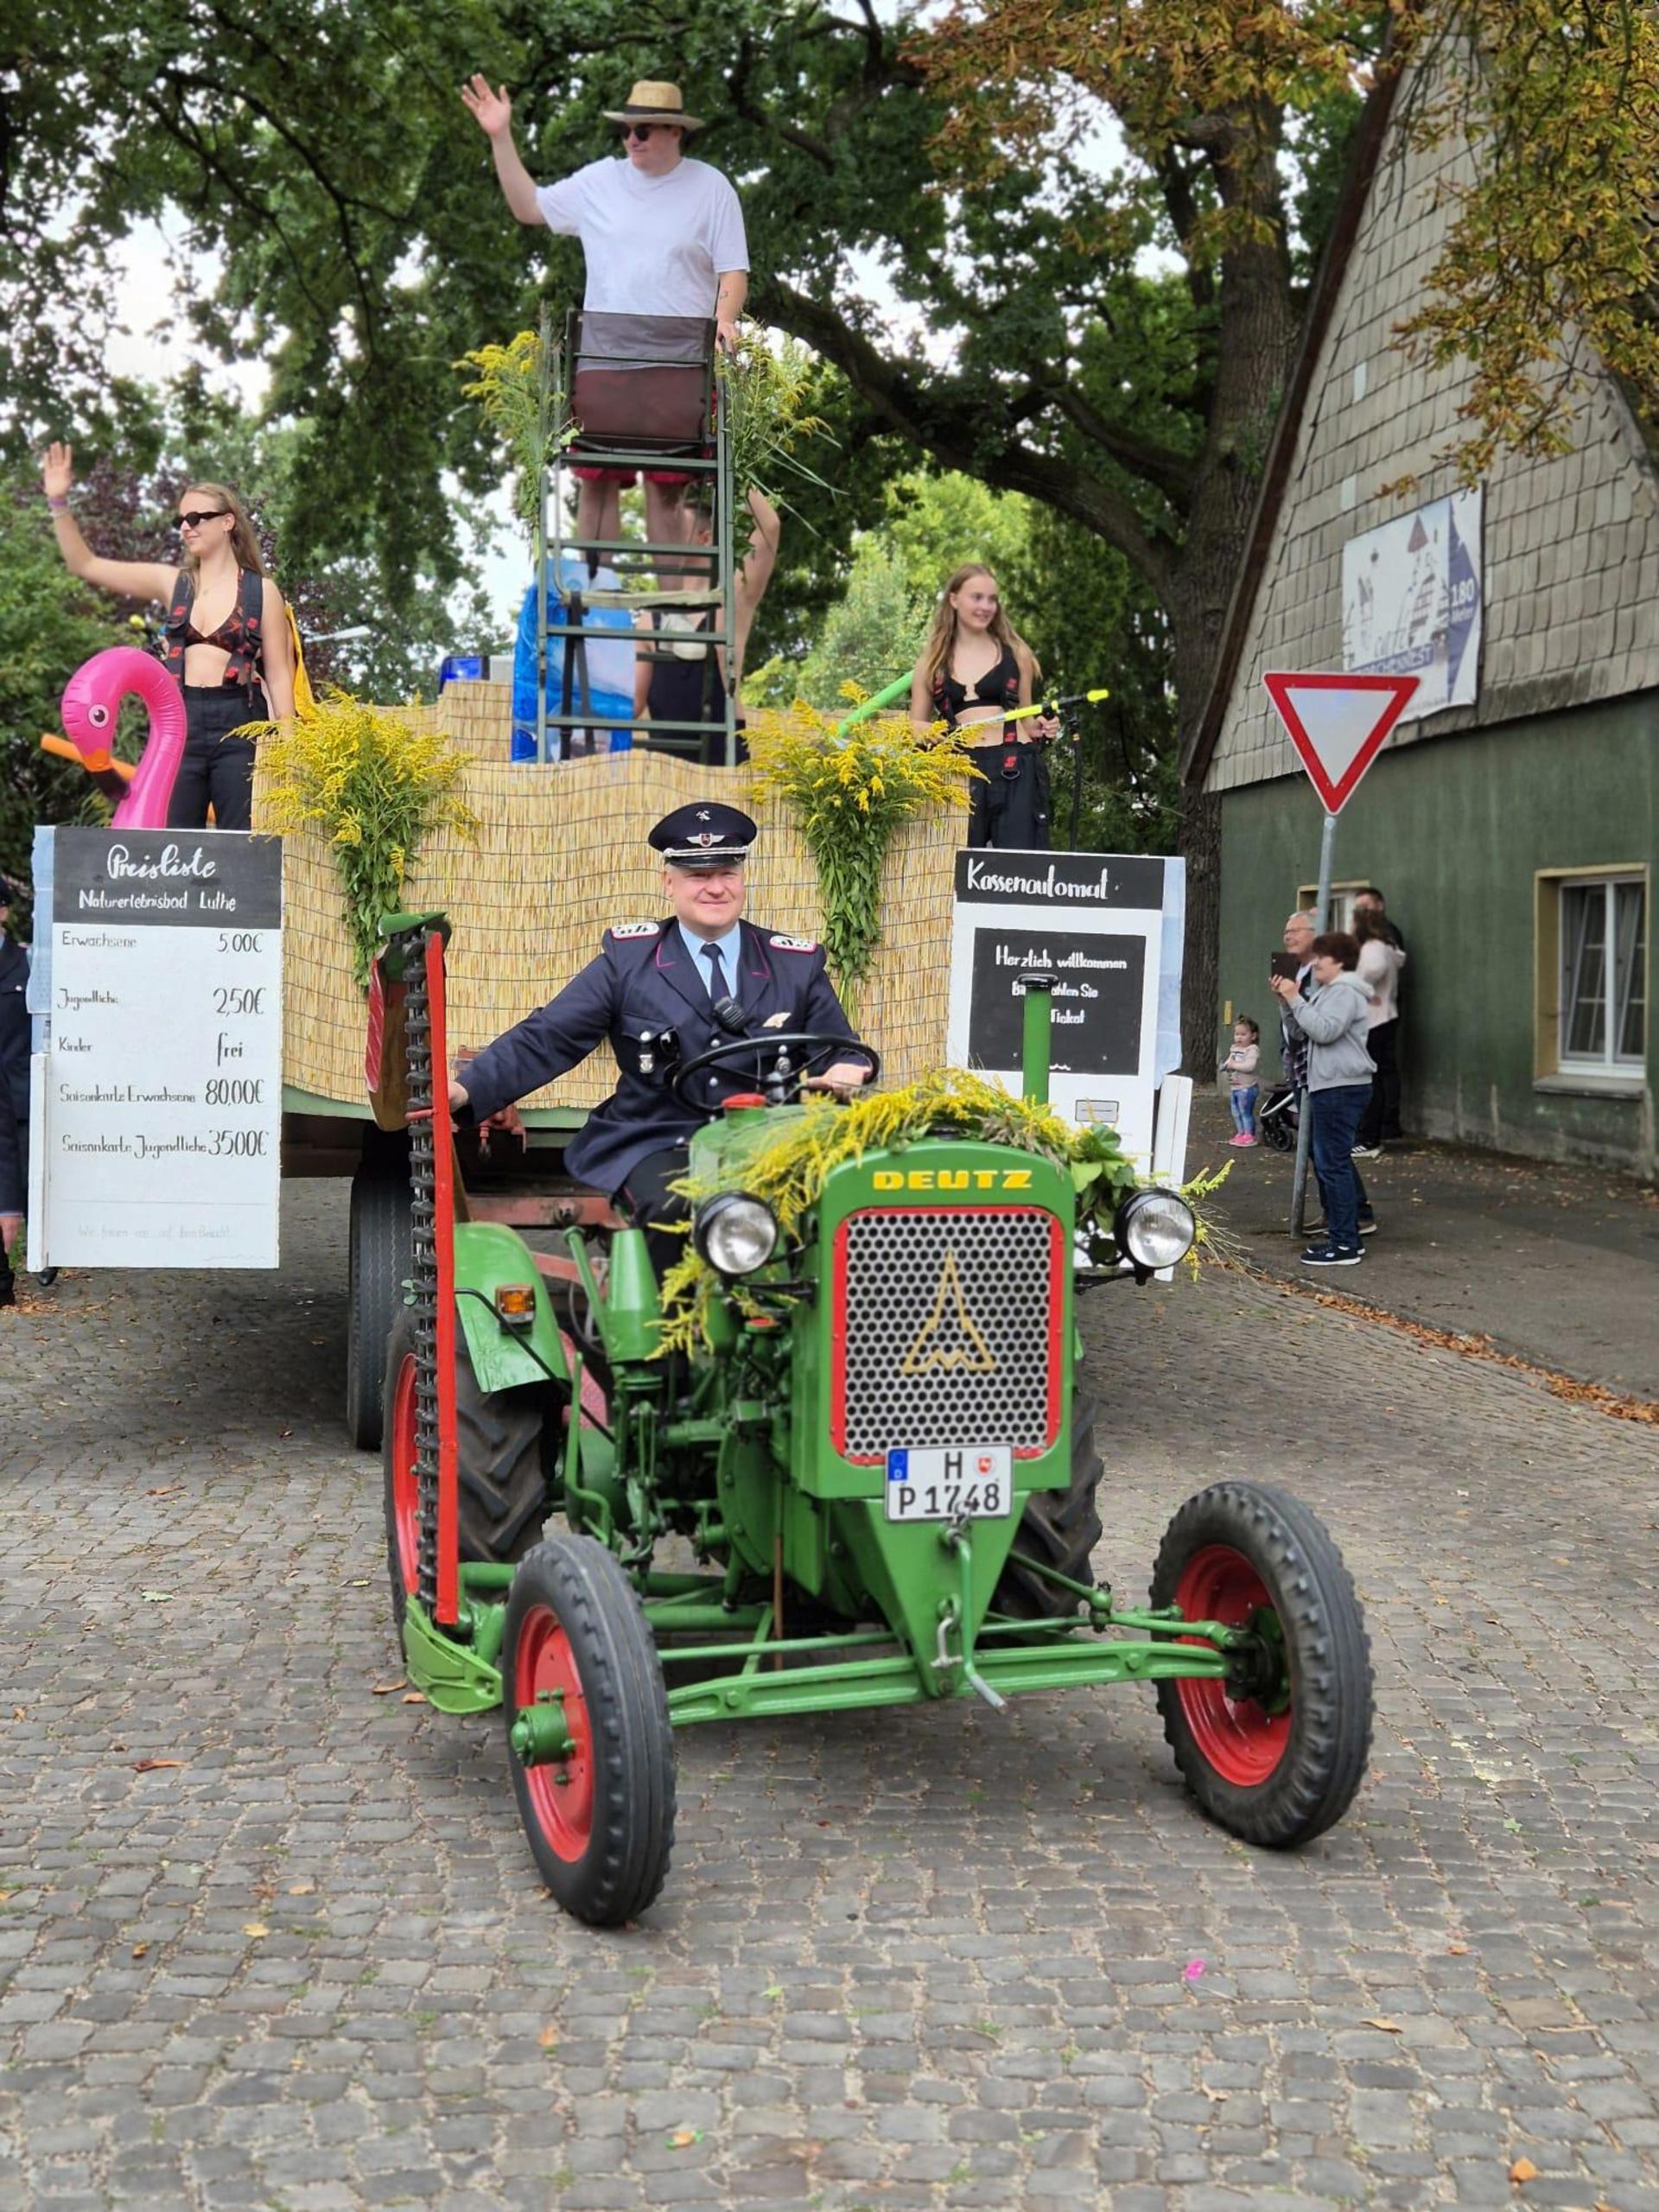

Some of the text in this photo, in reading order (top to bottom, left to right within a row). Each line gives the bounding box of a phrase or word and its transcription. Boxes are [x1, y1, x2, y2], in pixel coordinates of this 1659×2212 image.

[1451, 577, 1474, 606] 180
[106, 843, 216, 880] Preisliste
[967, 858, 1109, 899] Kassenautomat
[79, 889, 238, 912] Naturerlebnisbad Luthe
[61, 931, 137, 949] Erwachsene
[995, 945, 1128, 969] Herzlich willkommen
[212, 988, 268, 1017] 2,50€
[1079, 983, 1100, 998] Sie
[1050, 1008, 1085, 1024] Ticket
[59, 1033, 244, 1067] Kinder frei
[60, 1084, 125, 1103] Saisonkarte
[127, 1085, 196, 1103] Erwachsene
[62, 1134, 131, 1153] Saisonkarte
[134, 1135, 207, 1160] Jugendliche
[873, 1170, 1033, 1190] DEUTZ
[944, 1452, 963, 1479] H
[899, 1483, 1000, 1515] P 1748
